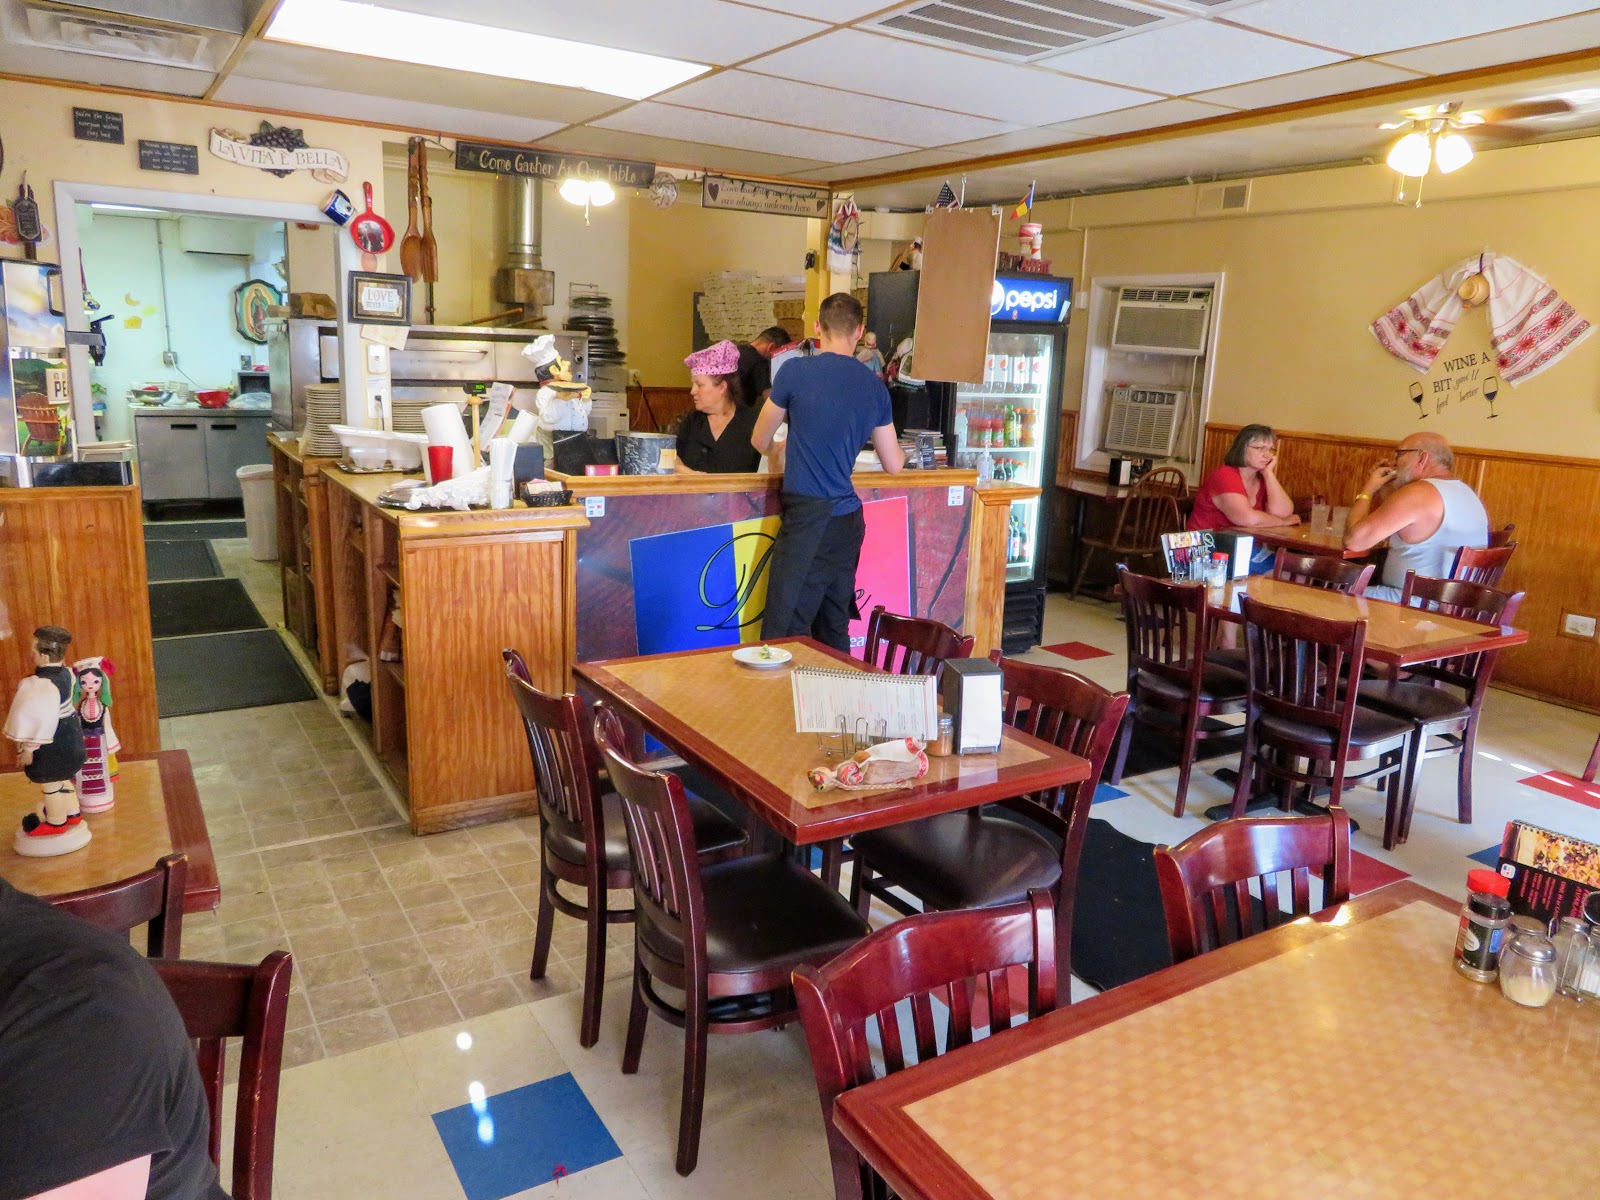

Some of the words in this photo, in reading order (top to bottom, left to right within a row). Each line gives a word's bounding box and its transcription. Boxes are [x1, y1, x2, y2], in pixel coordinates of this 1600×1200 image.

[218, 139, 237, 159] LA
[239, 145, 275, 165] VITA
[295, 152, 343, 171] BELLA
[479, 149, 511, 172] Come
[514, 154, 555, 177] Gather
[606, 164, 637, 184] Table
[720, 198, 734, 206] are
[367, 289, 393, 302] LOVE
[1006, 289, 1057, 313] pepsi
[1443, 354, 1477, 372] WINE
[1481, 351, 1491, 364] A
[1433, 377, 1453, 394] BIT
